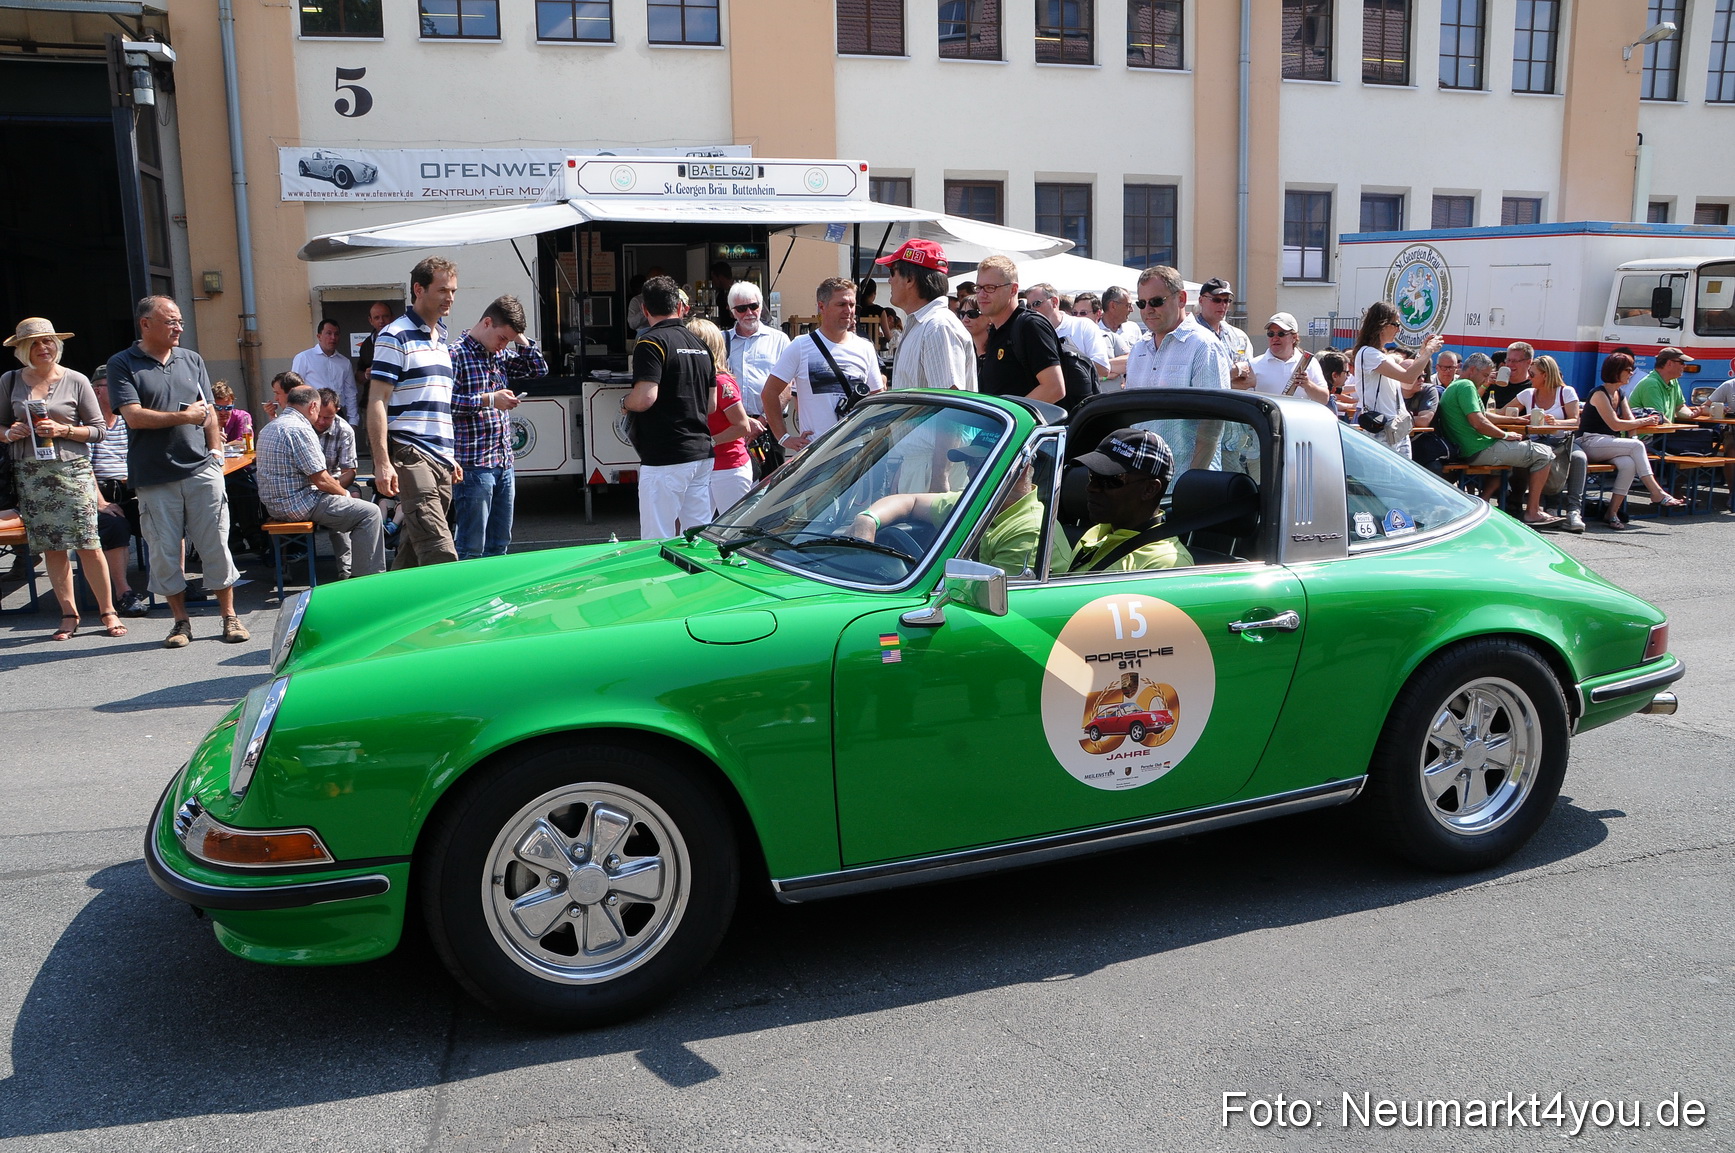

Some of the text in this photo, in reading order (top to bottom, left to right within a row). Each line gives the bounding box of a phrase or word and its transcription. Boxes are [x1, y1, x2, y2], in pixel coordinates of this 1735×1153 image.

[334, 66, 373, 118] 5
[731, 165, 751, 177] 642
[422, 187, 485, 197] ZENTRUM
[664, 182, 776, 197] St. Georgen Bräu Buttenheim
[1402, 248, 1428, 264] Georgen
[1428, 248, 1441, 270] Bräu
[1466, 313, 1481, 327] 1624
[1360, 523, 1373, 534] 66
[1291, 532, 1343, 543] targa
[1106, 600, 1148, 640] 15
[1084, 645, 1174, 664] PORSCHE
[1118, 659, 1142, 670] 911
[1106, 748, 1151, 761] JAHRE
